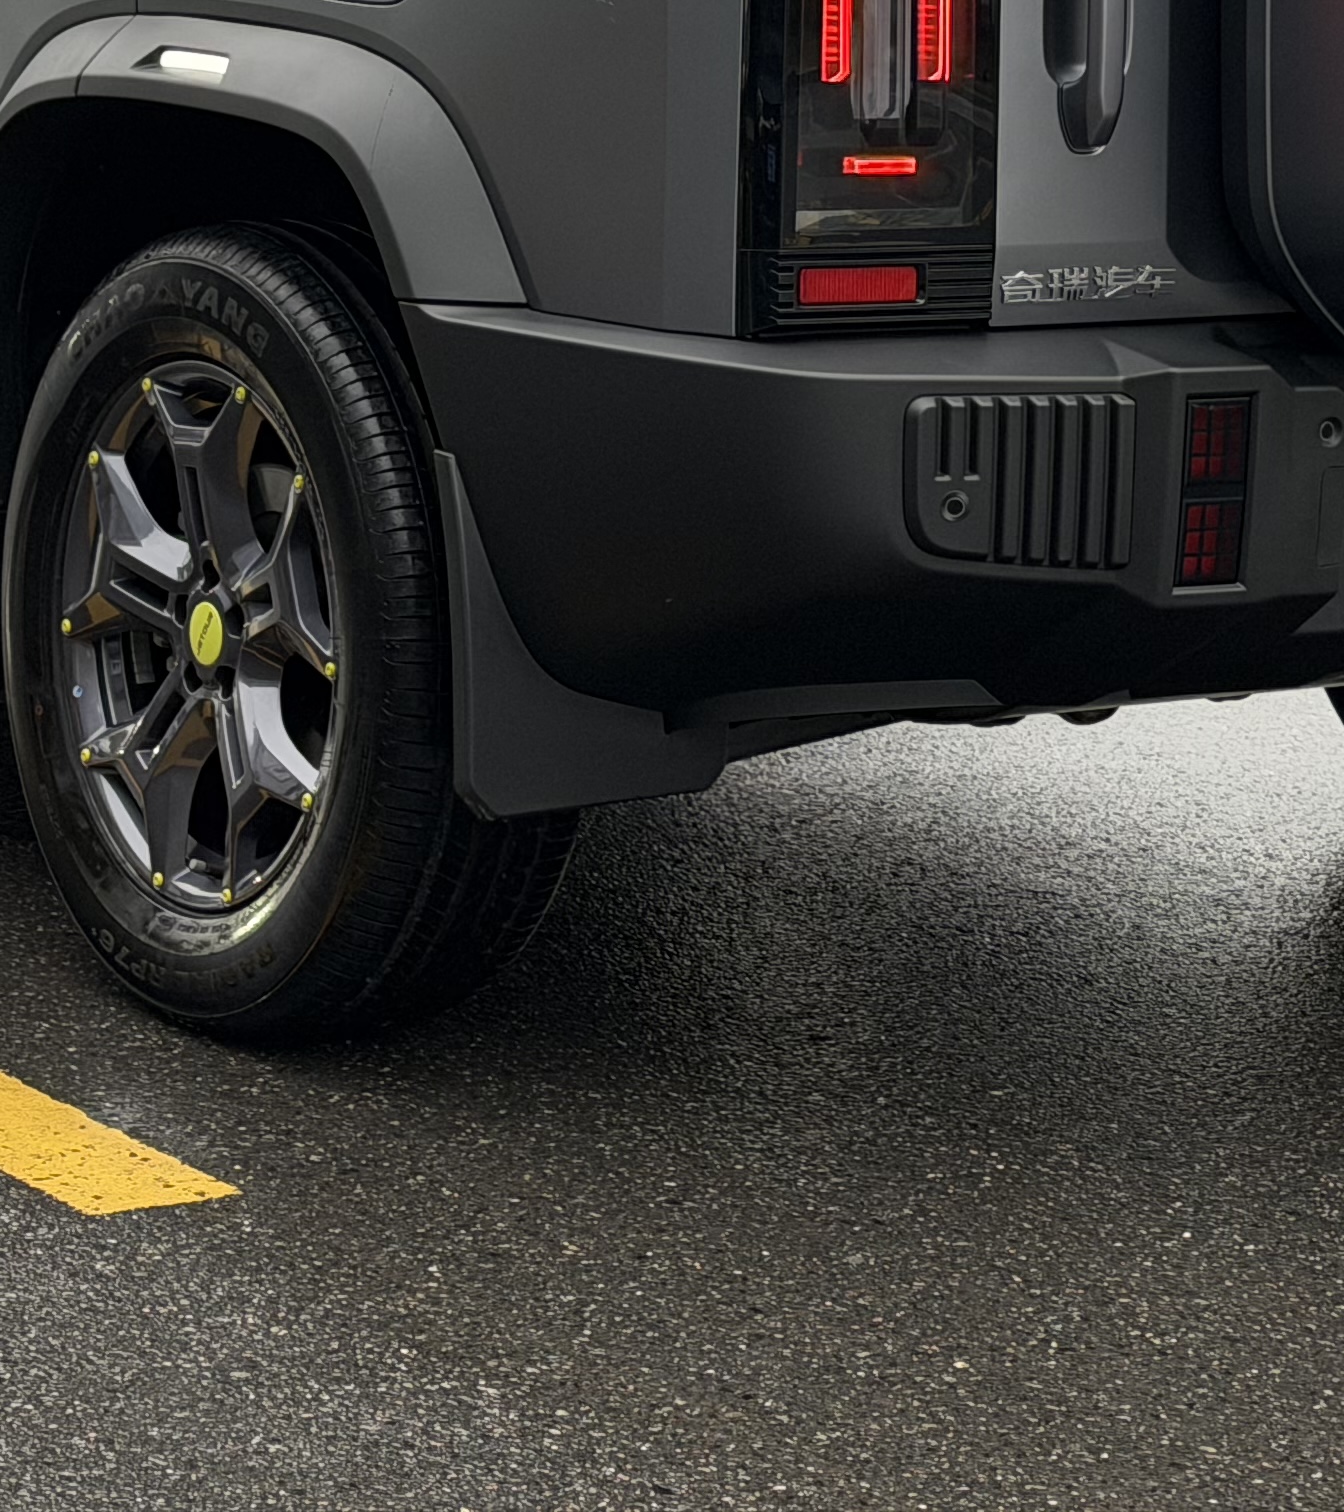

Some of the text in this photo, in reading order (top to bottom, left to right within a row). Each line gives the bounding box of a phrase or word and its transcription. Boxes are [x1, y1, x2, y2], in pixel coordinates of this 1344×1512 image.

[1001, 264, 1177, 304] 奇瑞汽车
[180, 277, 270, 358] YANG
